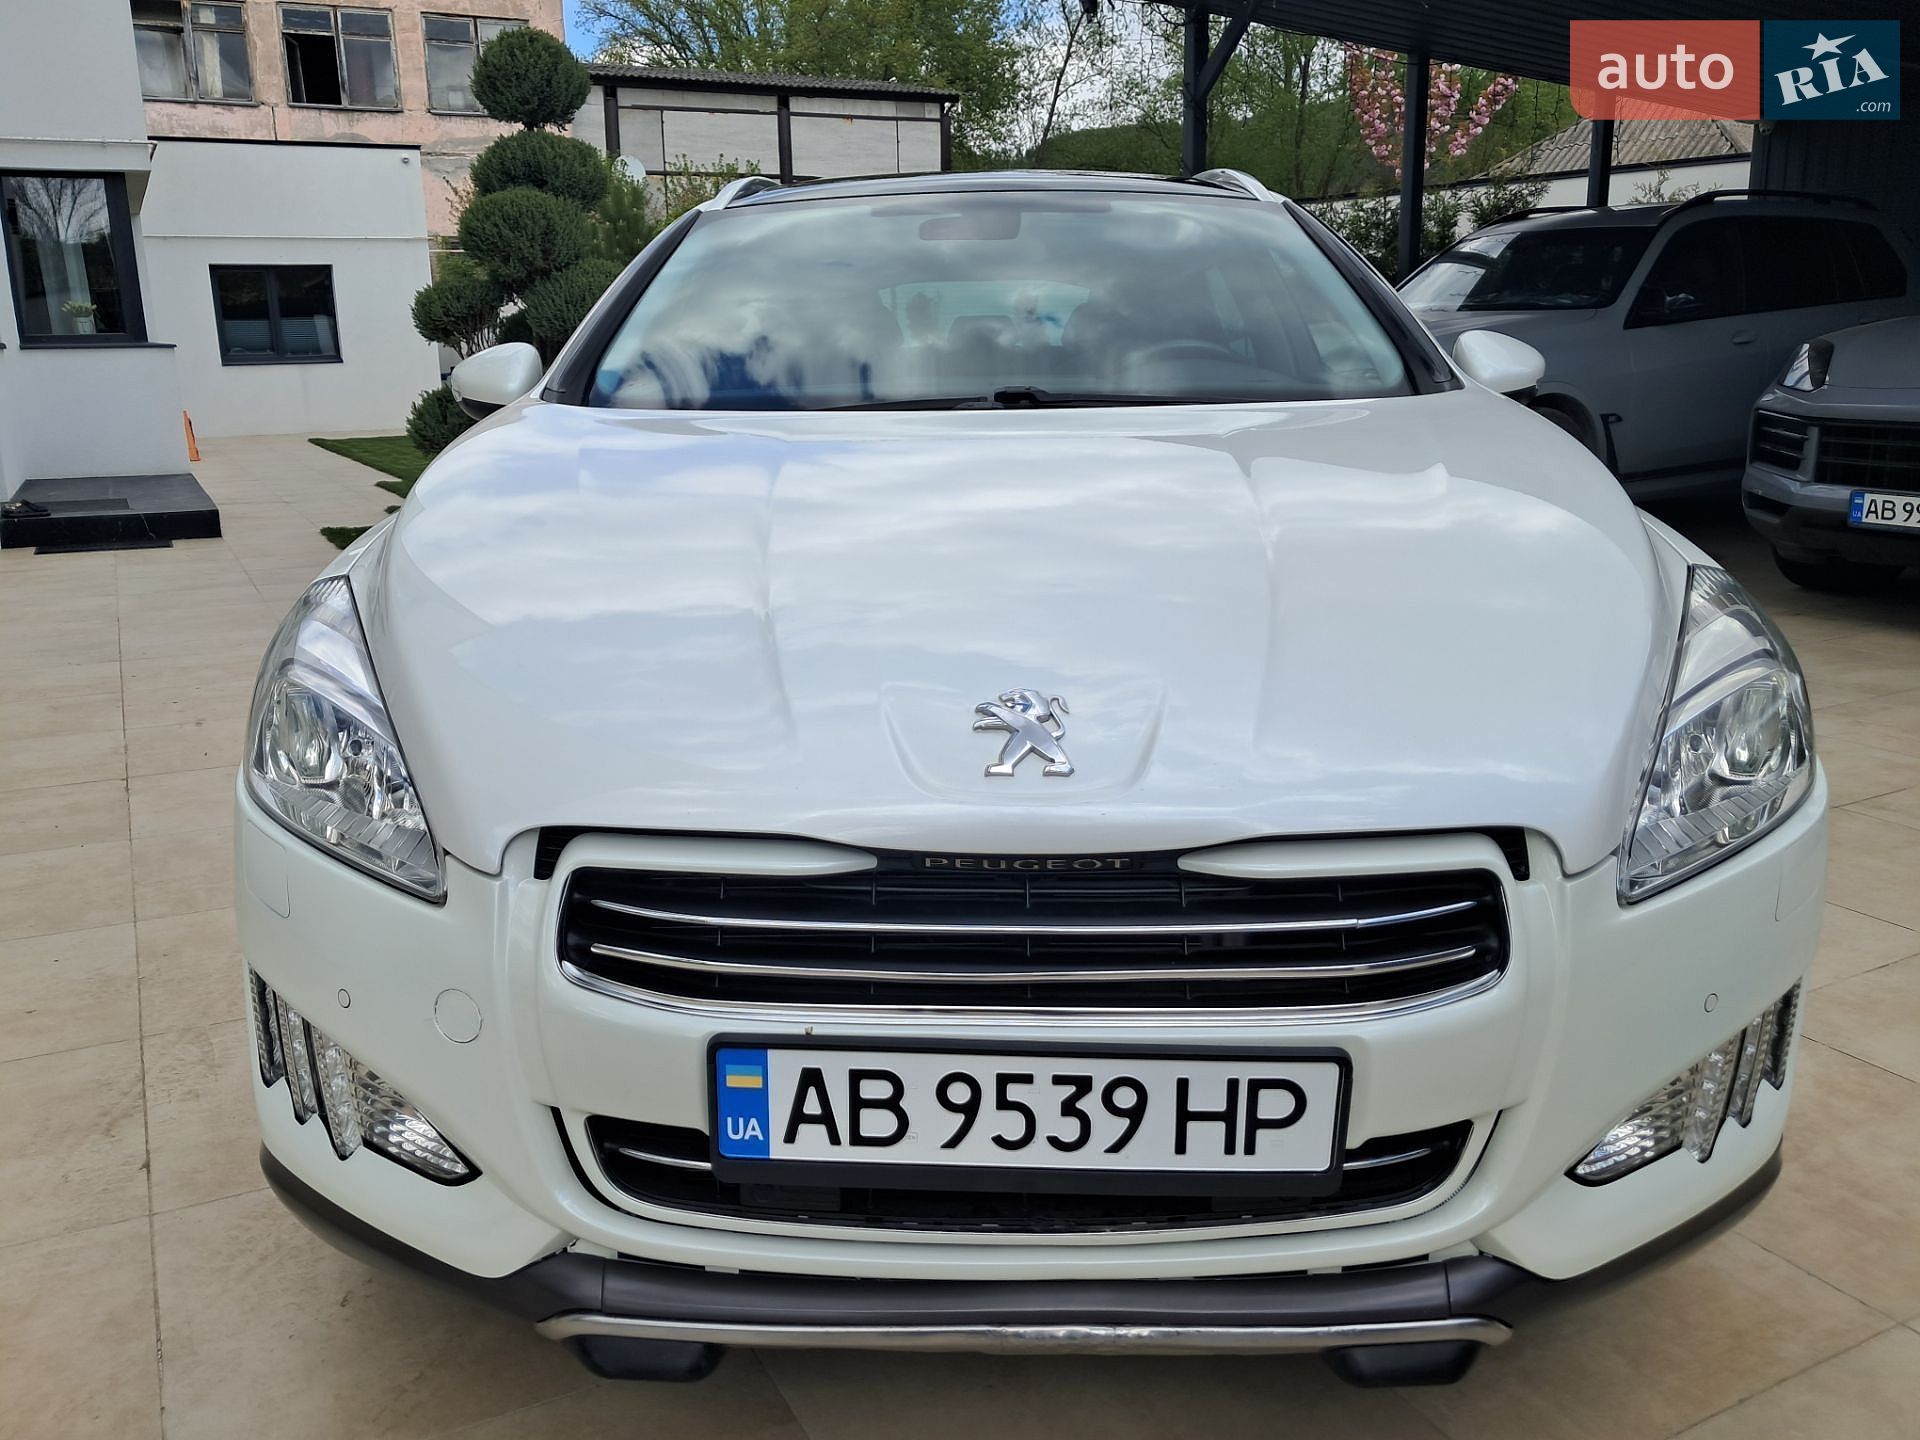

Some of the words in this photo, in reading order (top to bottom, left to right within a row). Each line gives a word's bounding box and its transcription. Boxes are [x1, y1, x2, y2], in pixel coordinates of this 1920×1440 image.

[1865, 499, 1896, 520] AB
[924, 857, 1130, 870] PEUGEOT
[783, 1067, 910, 1147] AB
[935, 1071, 1149, 1154] 9539
[1174, 1077, 1308, 1156] HP
[726, 1117, 764, 1142] UA
